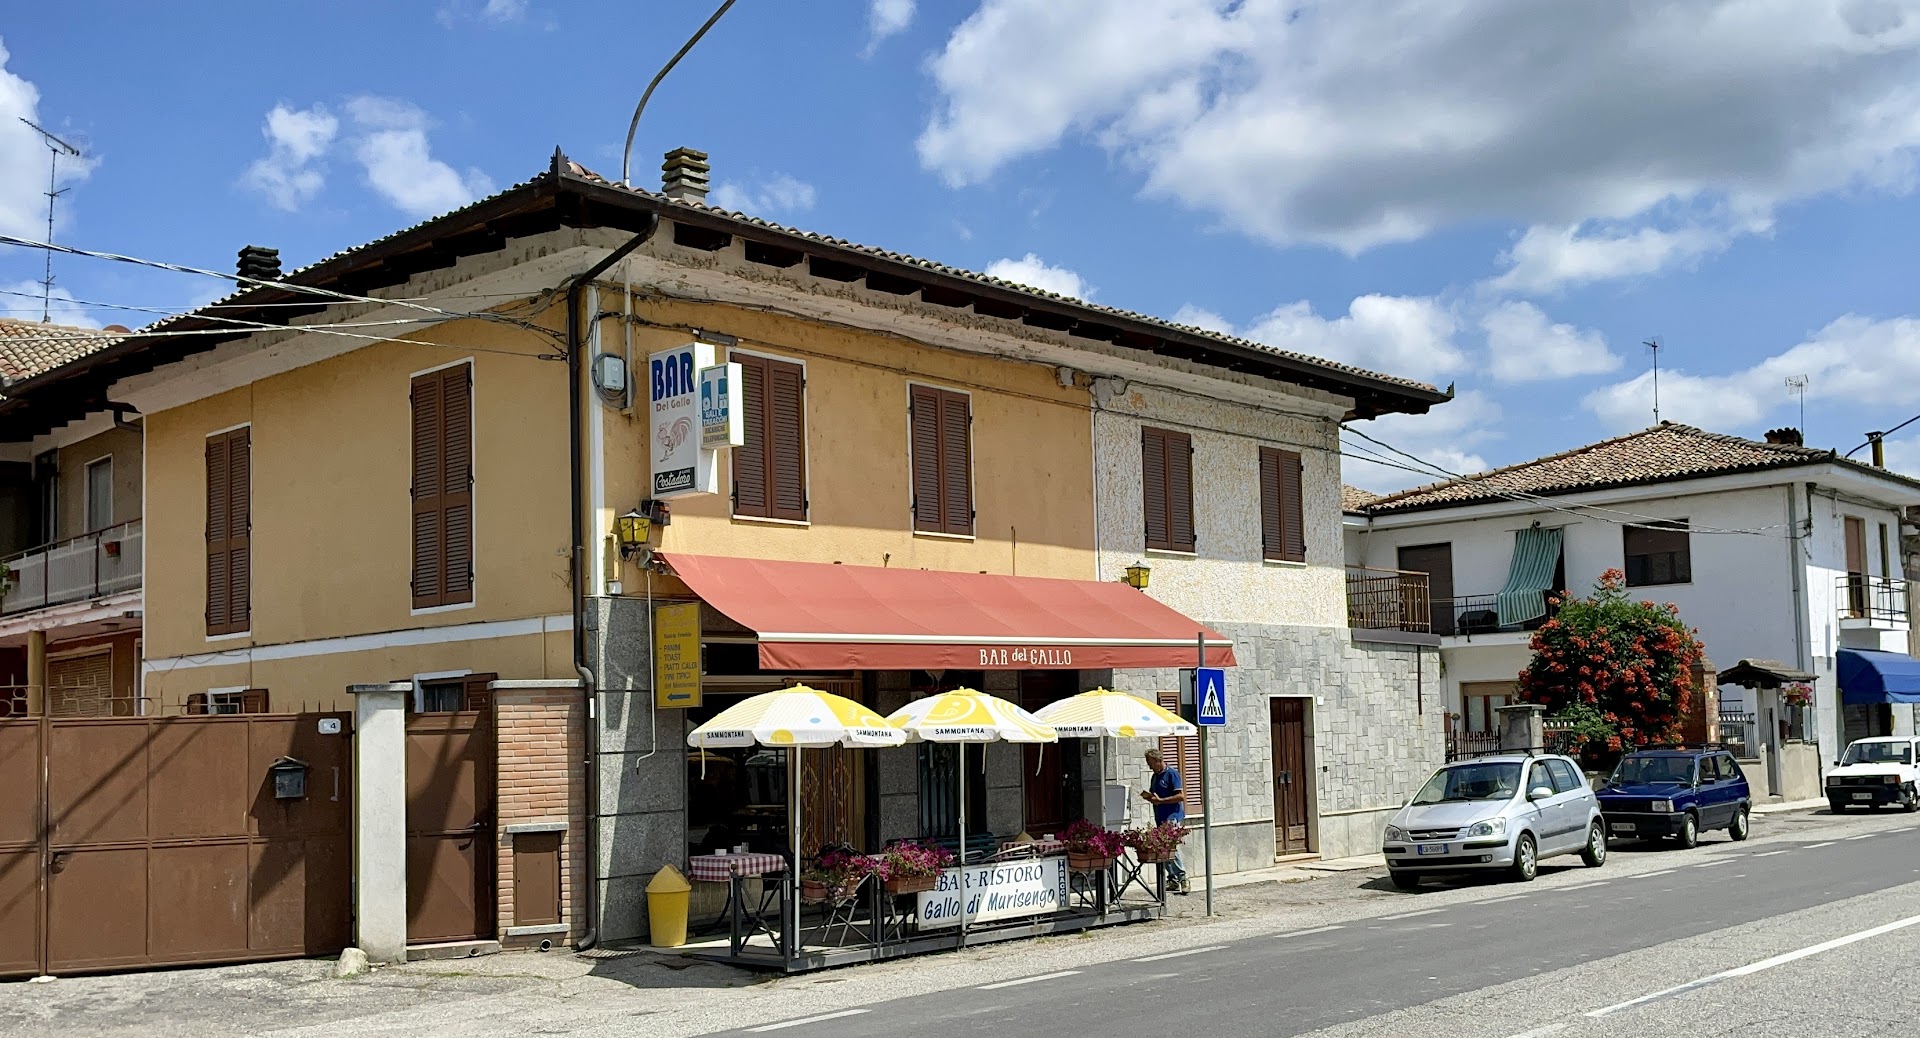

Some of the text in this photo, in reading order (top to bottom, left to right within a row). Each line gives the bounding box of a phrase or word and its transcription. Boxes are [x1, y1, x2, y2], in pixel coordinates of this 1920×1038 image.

[651, 352, 695, 401] BAR
[656, 397, 691, 412] Del Gallo
[979, 647, 1072, 665] BAR del GALLO
[330, 722, 337, 730] 4
[856, 729, 893, 737] SAMMONTANA
[935, 727, 985, 735] SAMMONTANA
[706, 730, 745, 739] SAMMONTANA
[938, 864, 1043, 892] BAR-RISTORO
[1058, 860, 1067, 907] TABACCHI
[924, 888, 1055, 920] Gallo di Murisengo
